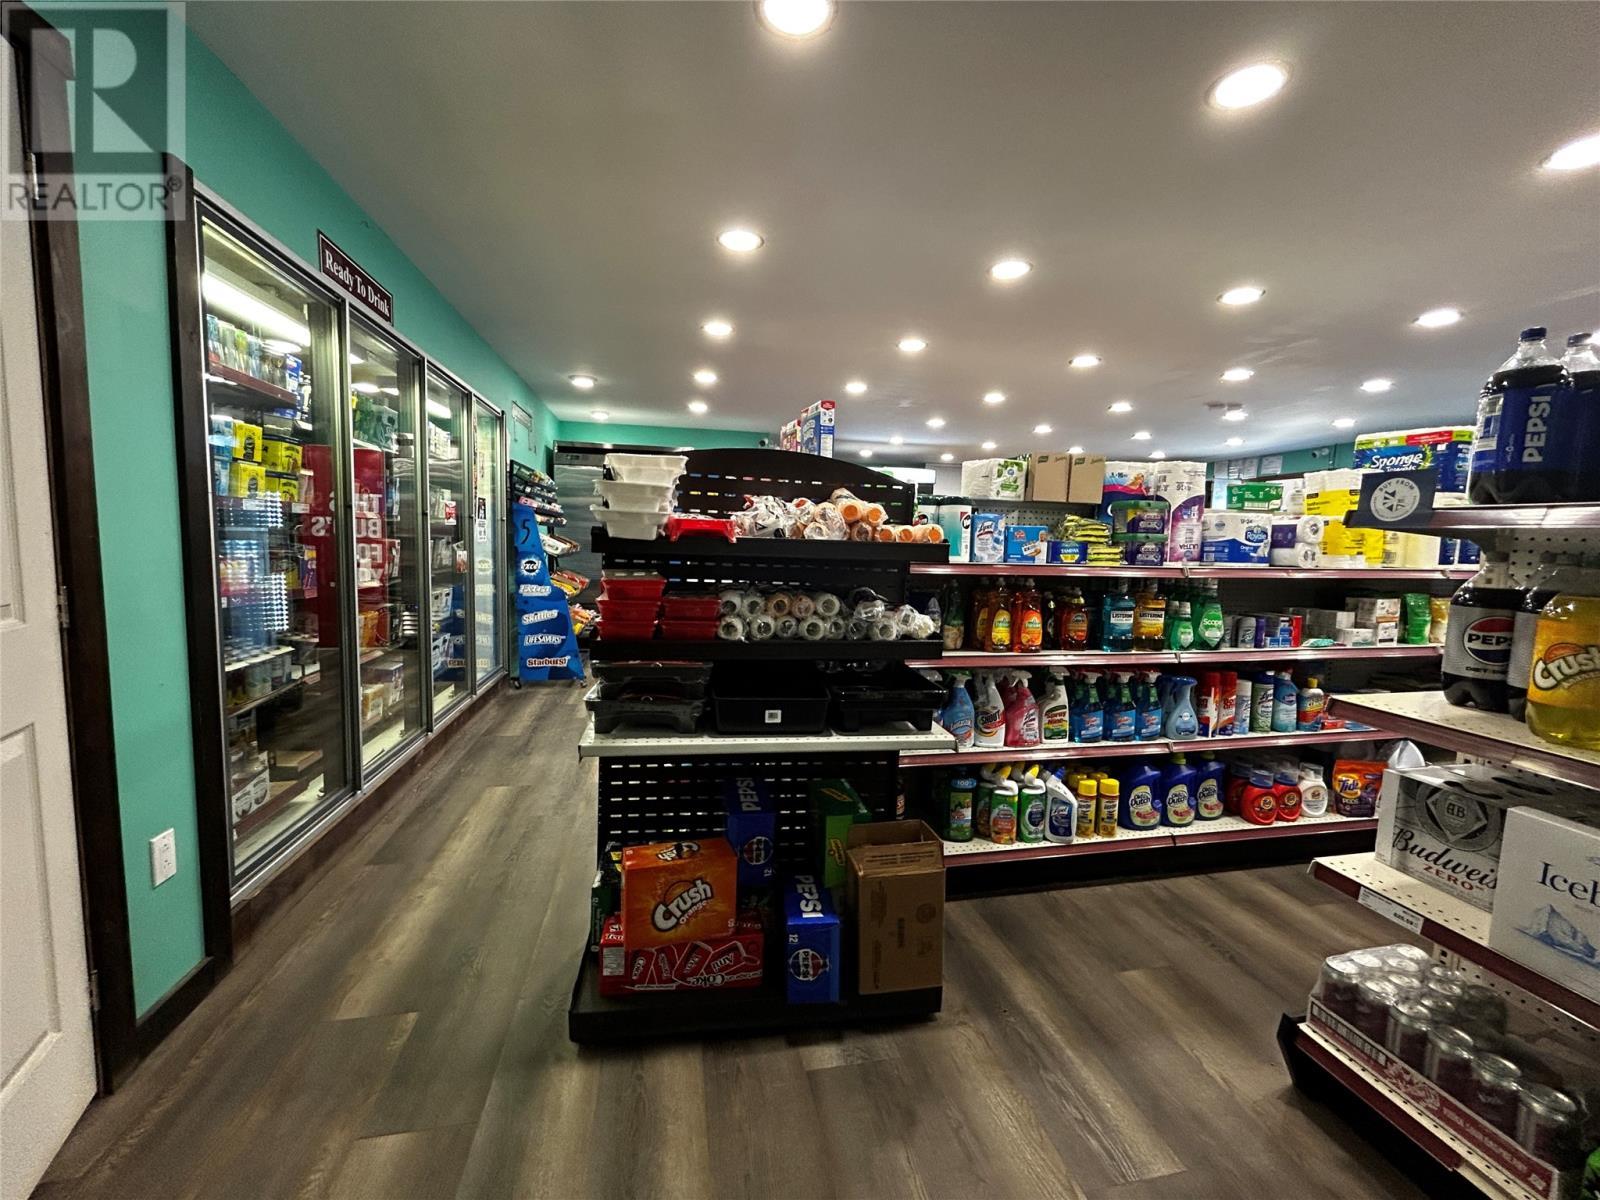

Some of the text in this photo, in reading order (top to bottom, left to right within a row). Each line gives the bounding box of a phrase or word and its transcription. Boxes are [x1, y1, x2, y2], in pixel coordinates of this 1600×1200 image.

[325, 249, 390, 317] Ready To Drink
[1522, 396, 1552, 462] PEPSI
[1371, 454, 1423, 471] Sponge
[1379, 480, 1415, 491] BUY FROM
[1246, 532, 1268, 541] Royale
[523, 610, 558, 624] Skittles
[1468, 633, 1512, 646] PEP
[1340, 779, 1359, 790] Tide
[1423, 864, 1474, 891] ZERO
[654, 880, 713, 930] Crush
[795, 875, 824, 918] PEPSI
[789, 934, 798, 943] 12
[801, 951, 810, 979] PEPSI
